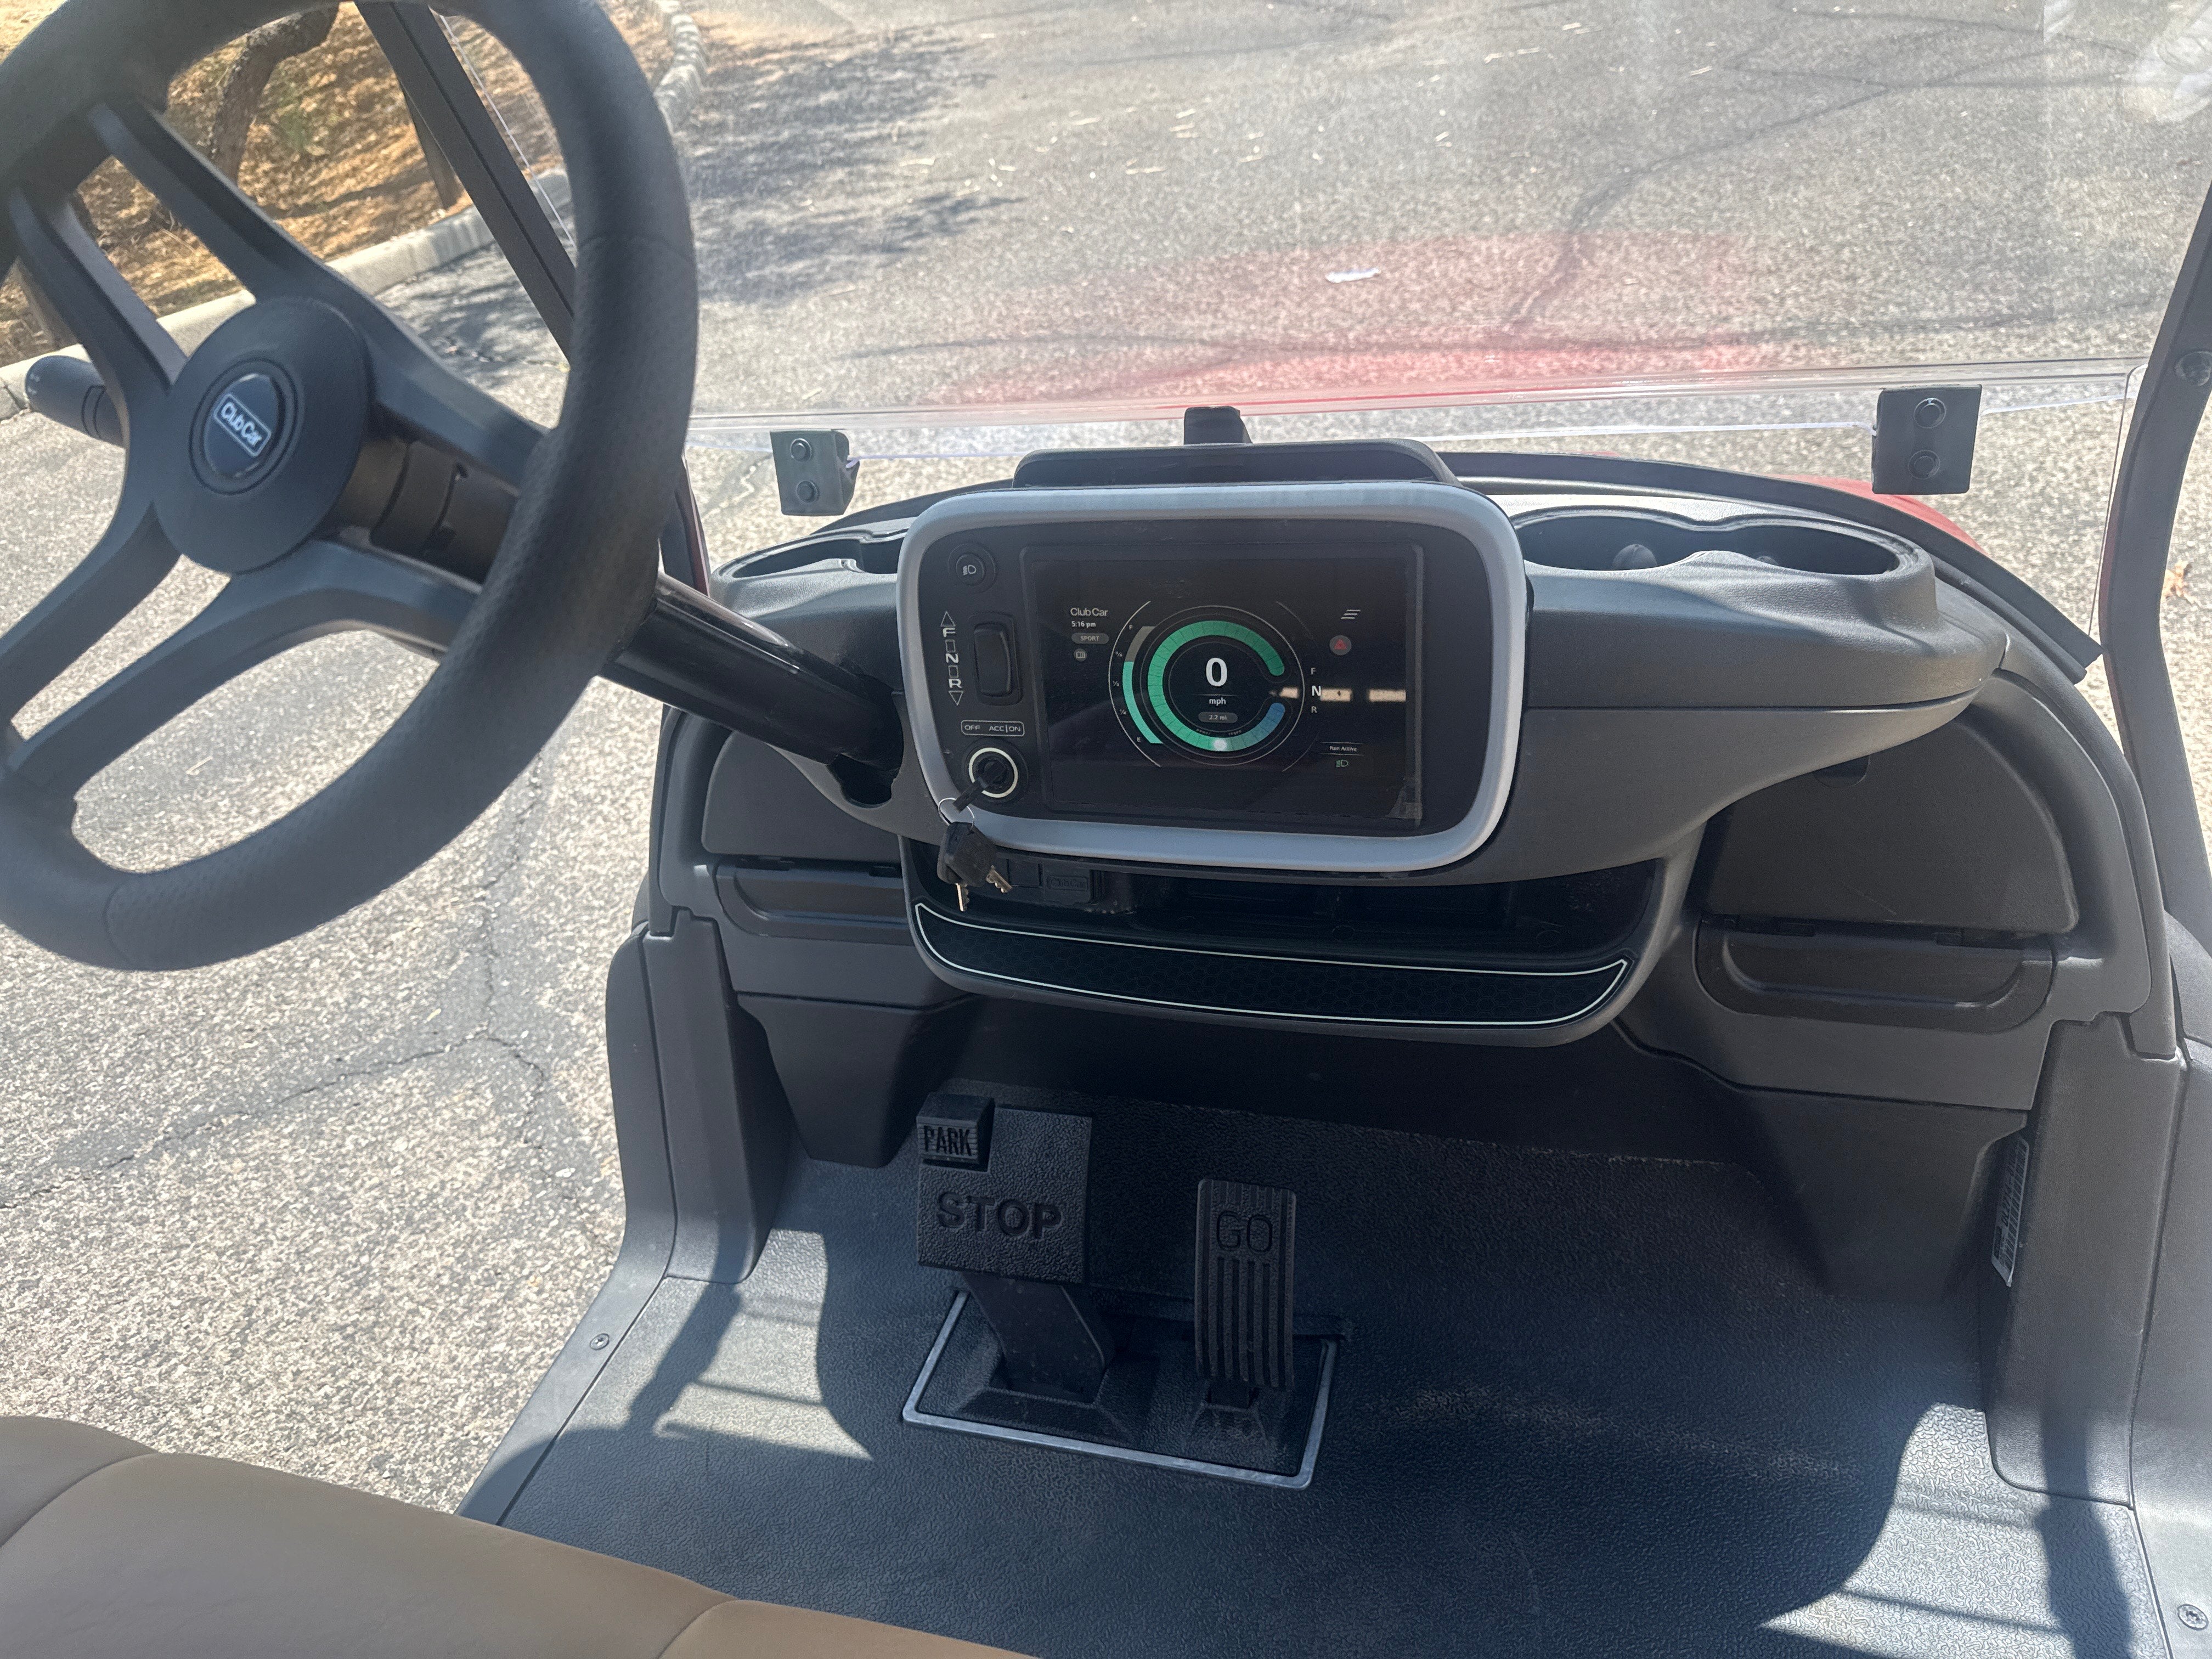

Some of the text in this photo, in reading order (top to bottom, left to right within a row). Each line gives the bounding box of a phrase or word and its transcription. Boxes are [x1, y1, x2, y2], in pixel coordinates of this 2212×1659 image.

[221, 402, 263, 447] Club Car
[1070, 607, 1108, 617] Club Car
[943, 627, 956, 637] F
[945, 653, 959, 663] N
[1206, 658, 1228, 686] 0
[949, 679, 962, 689] R
[1312, 685, 1321, 697] N
[1209, 697, 1226, 706] mph
[923, 1125, 972, 1156] PARK
[936, 1192, 1064, 1240] STOP
[1216, 1210, 1273, 1254] GO
